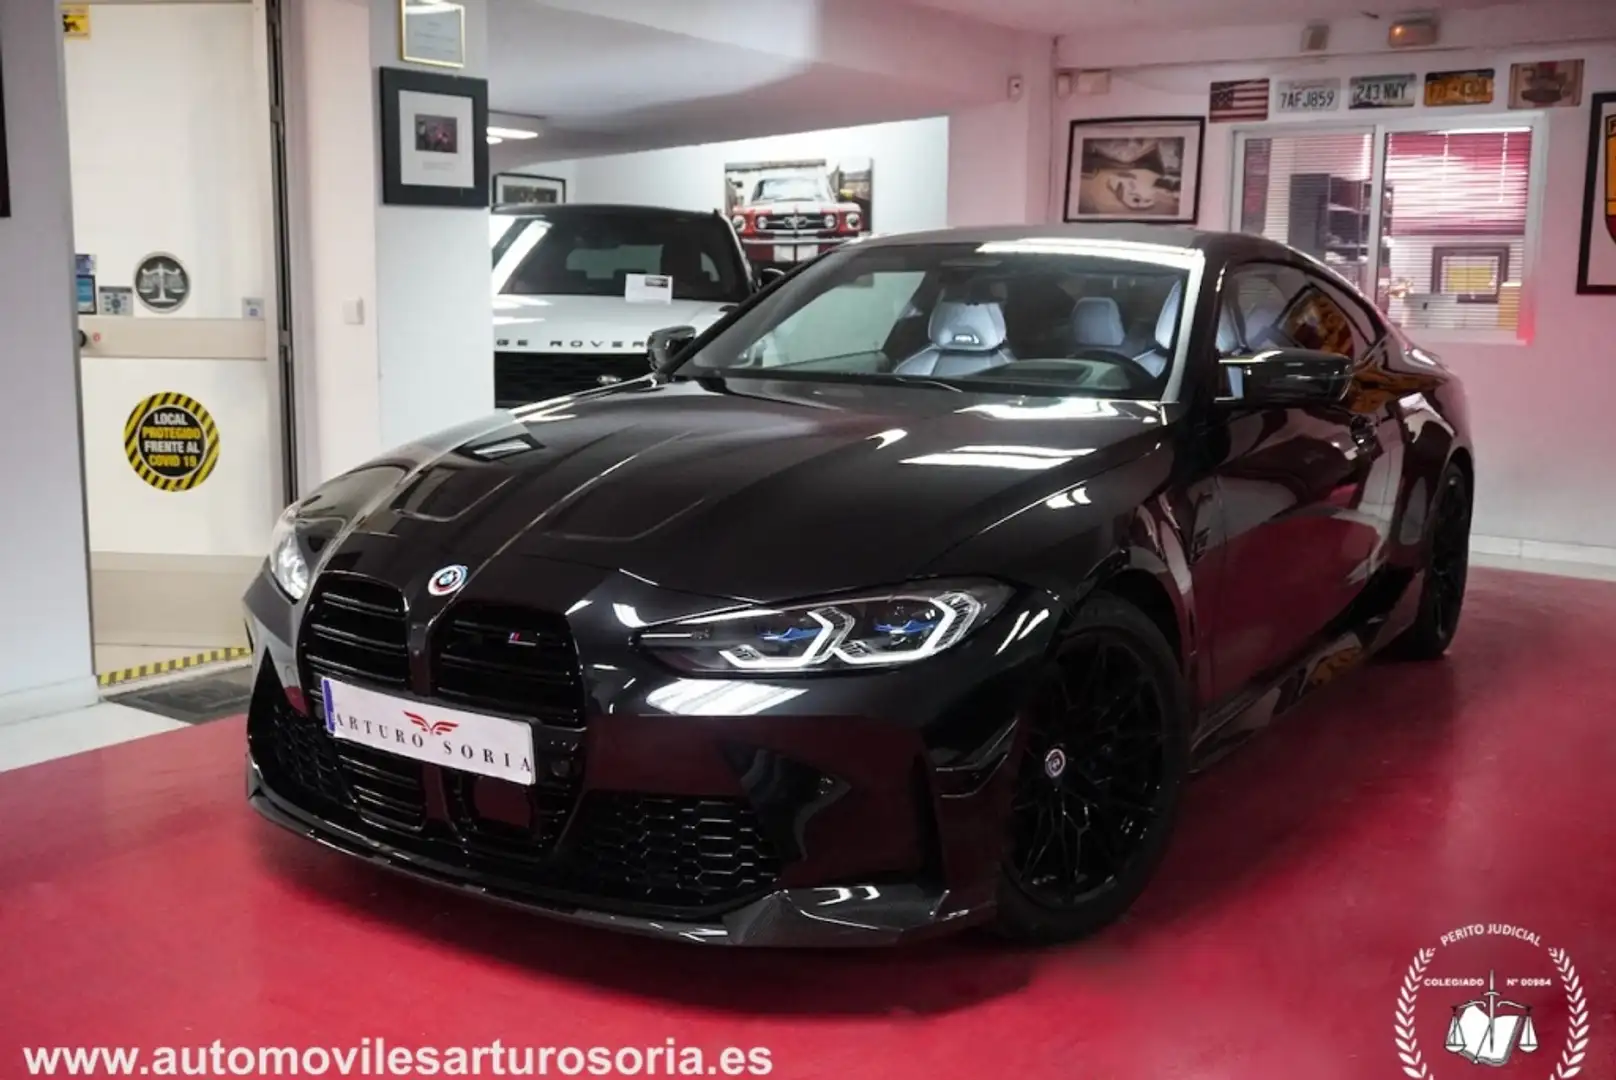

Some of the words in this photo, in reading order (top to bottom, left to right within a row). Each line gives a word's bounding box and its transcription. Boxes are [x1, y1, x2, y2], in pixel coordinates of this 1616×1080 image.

[1281, 91, 1334, 109] 7AFJ859
[549, 340, 645, 348] ROVER
[154, 413, 188, 425] LOCAL
[144, 440, 184, 453] FRENTE
[186, 441, 200, 453] AL
[149, 454, 180, 467] COVID
[183, 455, 197, 467] 19
[334, 713, 423, 748] ARTURO
[443, 739, 531, 772] SORIA
